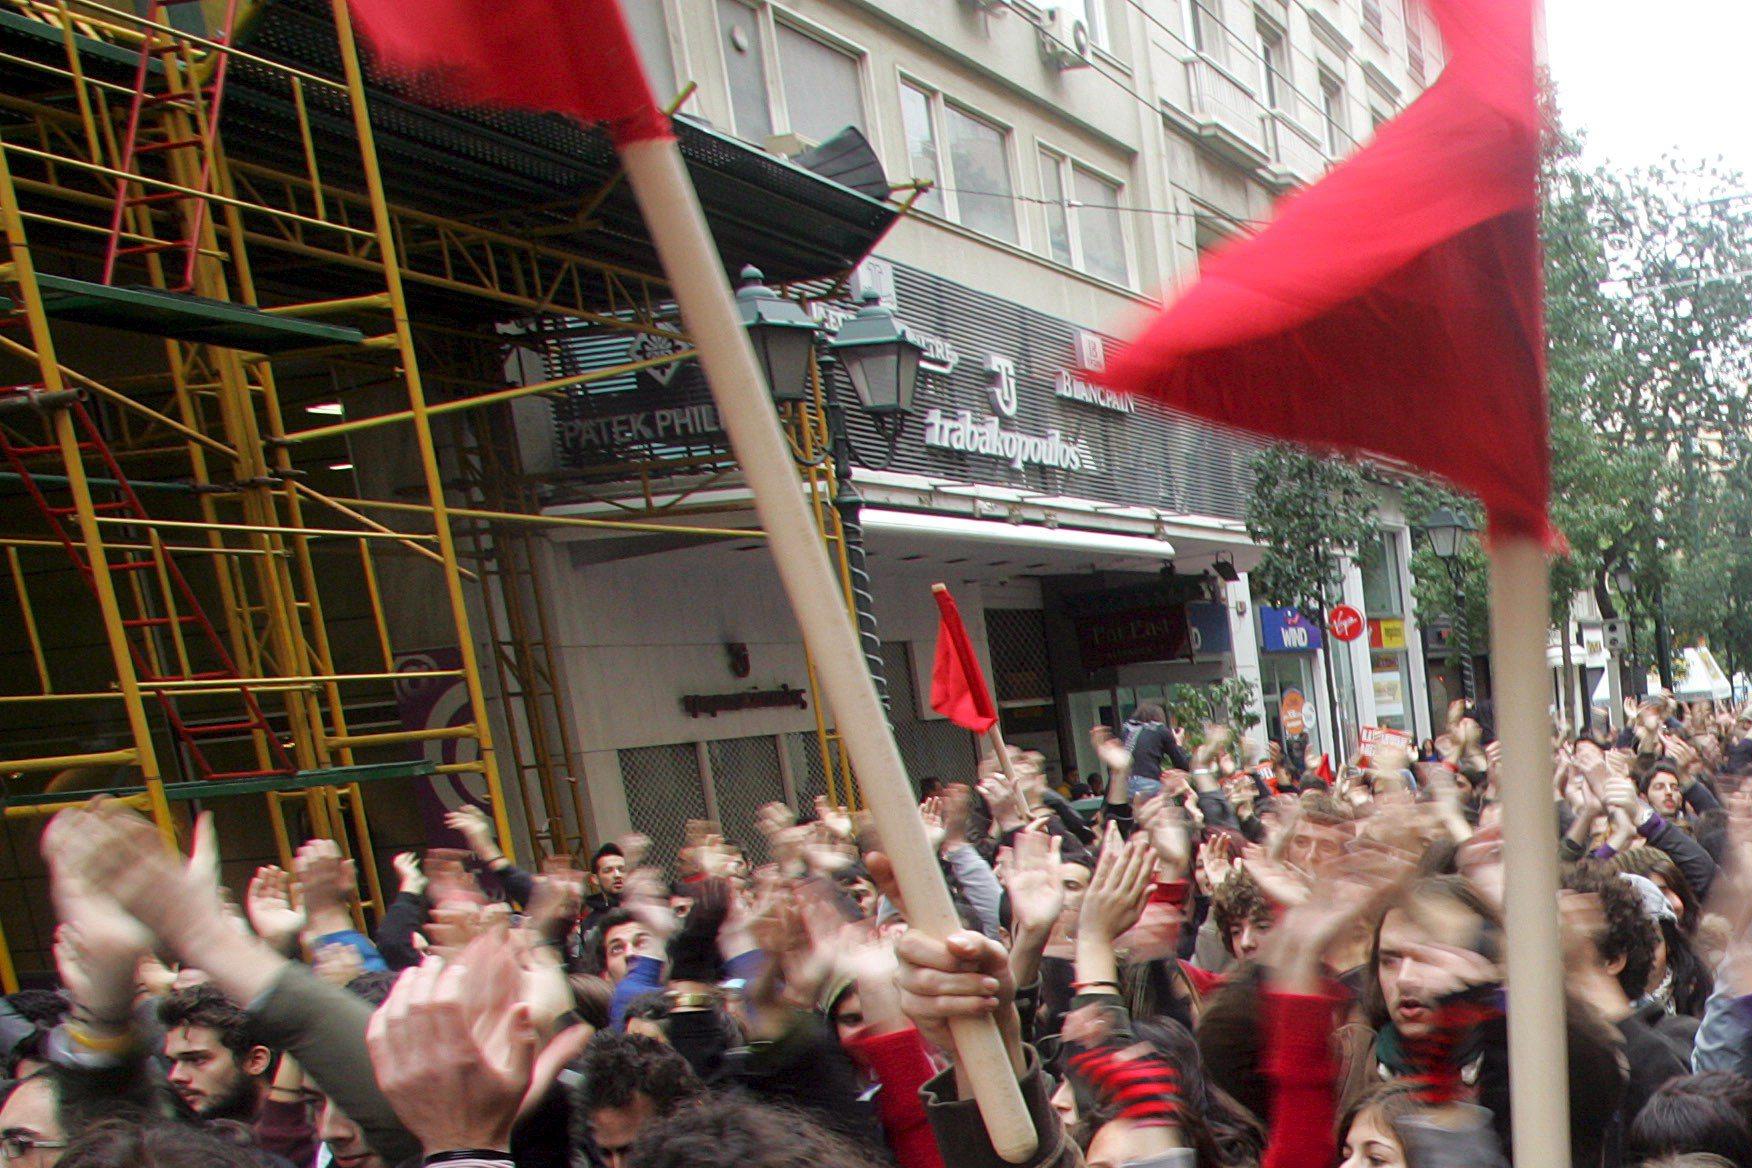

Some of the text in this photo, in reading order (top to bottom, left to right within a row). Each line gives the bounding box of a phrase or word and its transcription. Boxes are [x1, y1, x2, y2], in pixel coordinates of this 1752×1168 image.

[1056, 369, 1135, 414] BLANCPAIN
[563, 404, 724, 449] PATEK PHIL
[925, 408, 1082, 472] trabakopoulos
